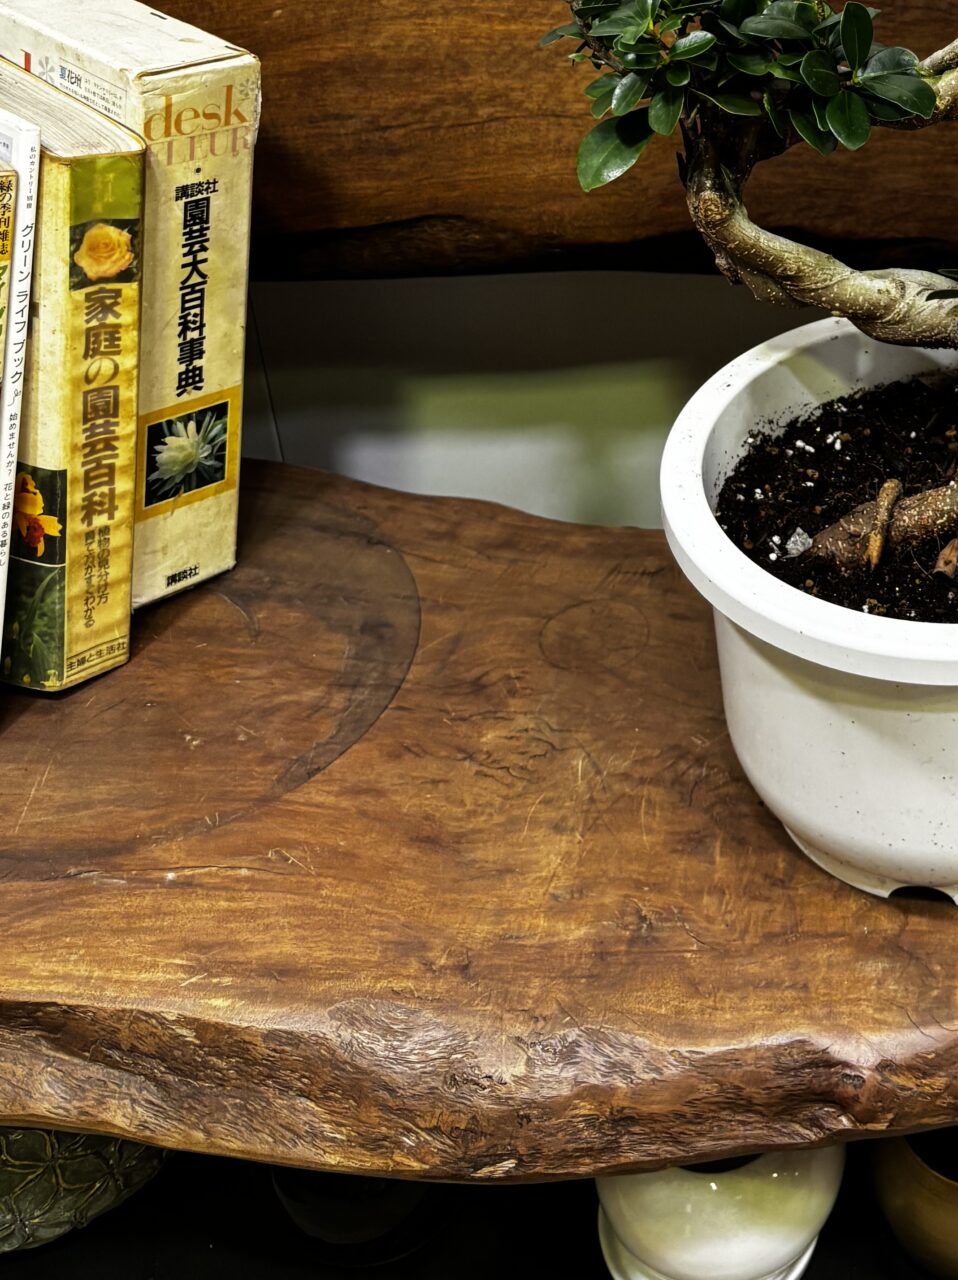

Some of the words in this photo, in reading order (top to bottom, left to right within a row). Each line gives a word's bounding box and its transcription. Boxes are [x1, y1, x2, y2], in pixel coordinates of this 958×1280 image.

[144, 85, 249, 141] desk
[175, 178, 218, 202] 講談社
[19, 223, 34, 283] グリーン
[15, 291, 28, 333] ライフ
[176, 196, 210, 397] 園芸大百科事典
[11, 339, 26, 384] ブック
[80, 286, 123, 528] 家庭の園芸百科
[84, 530, 96, 629] 育て方がすぐわかる
[97, 525, 110, 606] 植物の見分け方
[166, 564, 199, 588] 講談社
[66, 641, 127, 671] 主婦と生活社
